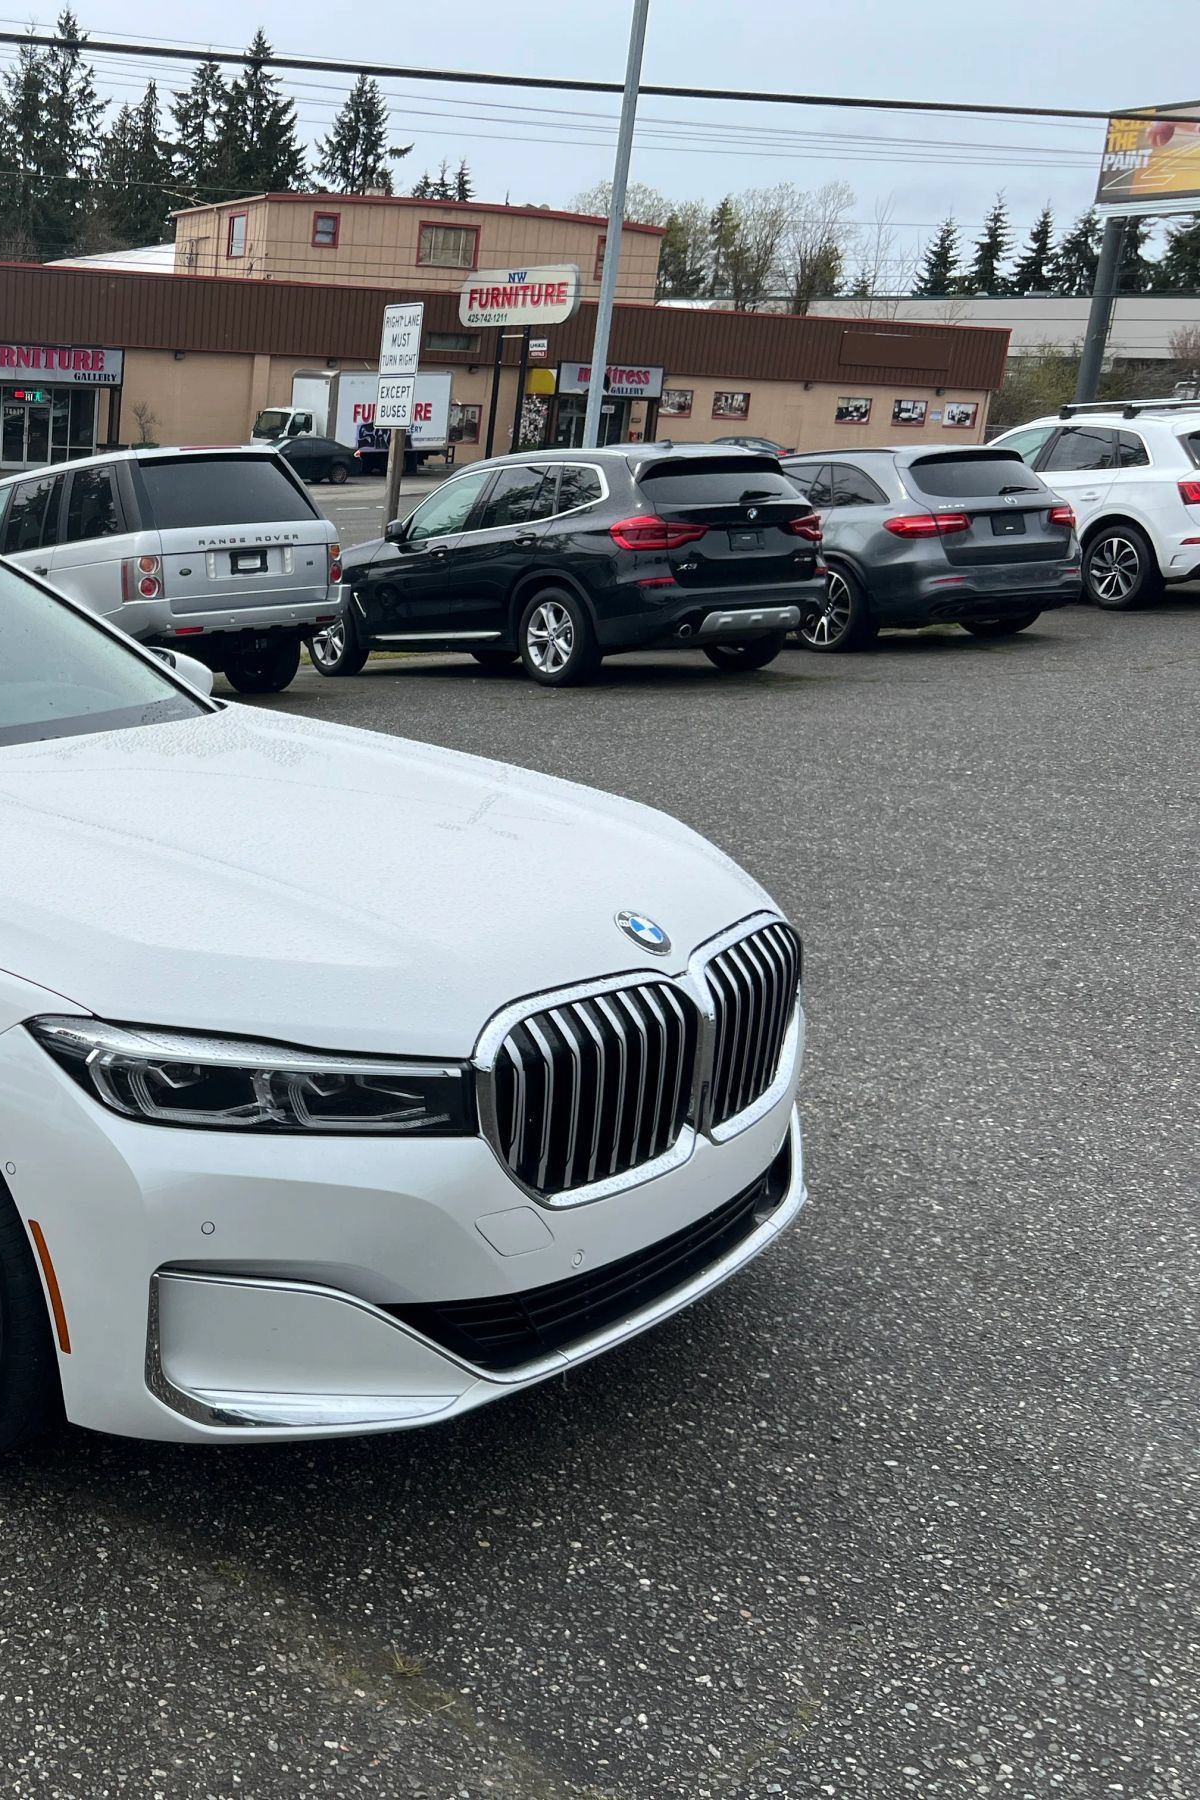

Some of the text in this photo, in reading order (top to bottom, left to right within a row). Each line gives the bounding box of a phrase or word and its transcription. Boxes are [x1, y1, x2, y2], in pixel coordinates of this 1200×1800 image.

[1107, 132, 1137, 152] THE
[1103, 149, 1153, 172] PAINT
[508, 272, 527, 283] NW
[468, 282, 569, 311] FURNITURE
[386, 313, 420, 328] RIGHT LANE
[467, 313, 508, 323] 425-742-1211
[391, 332, 411, 347] MUST
[382, 353, 417, 366] TURN RIGHT
[74, 371, 118, 382] GALLERY
[577, 366, 652, 385] mttress
[380, 385, 411, 399] EXCEPT
[610, 386, 645, 395] GALLERY
[380, 405, 407, 418] BUSES
[198, 534, 299, 546] RANGE ROVER
[676, 562, 698, 571] X3
